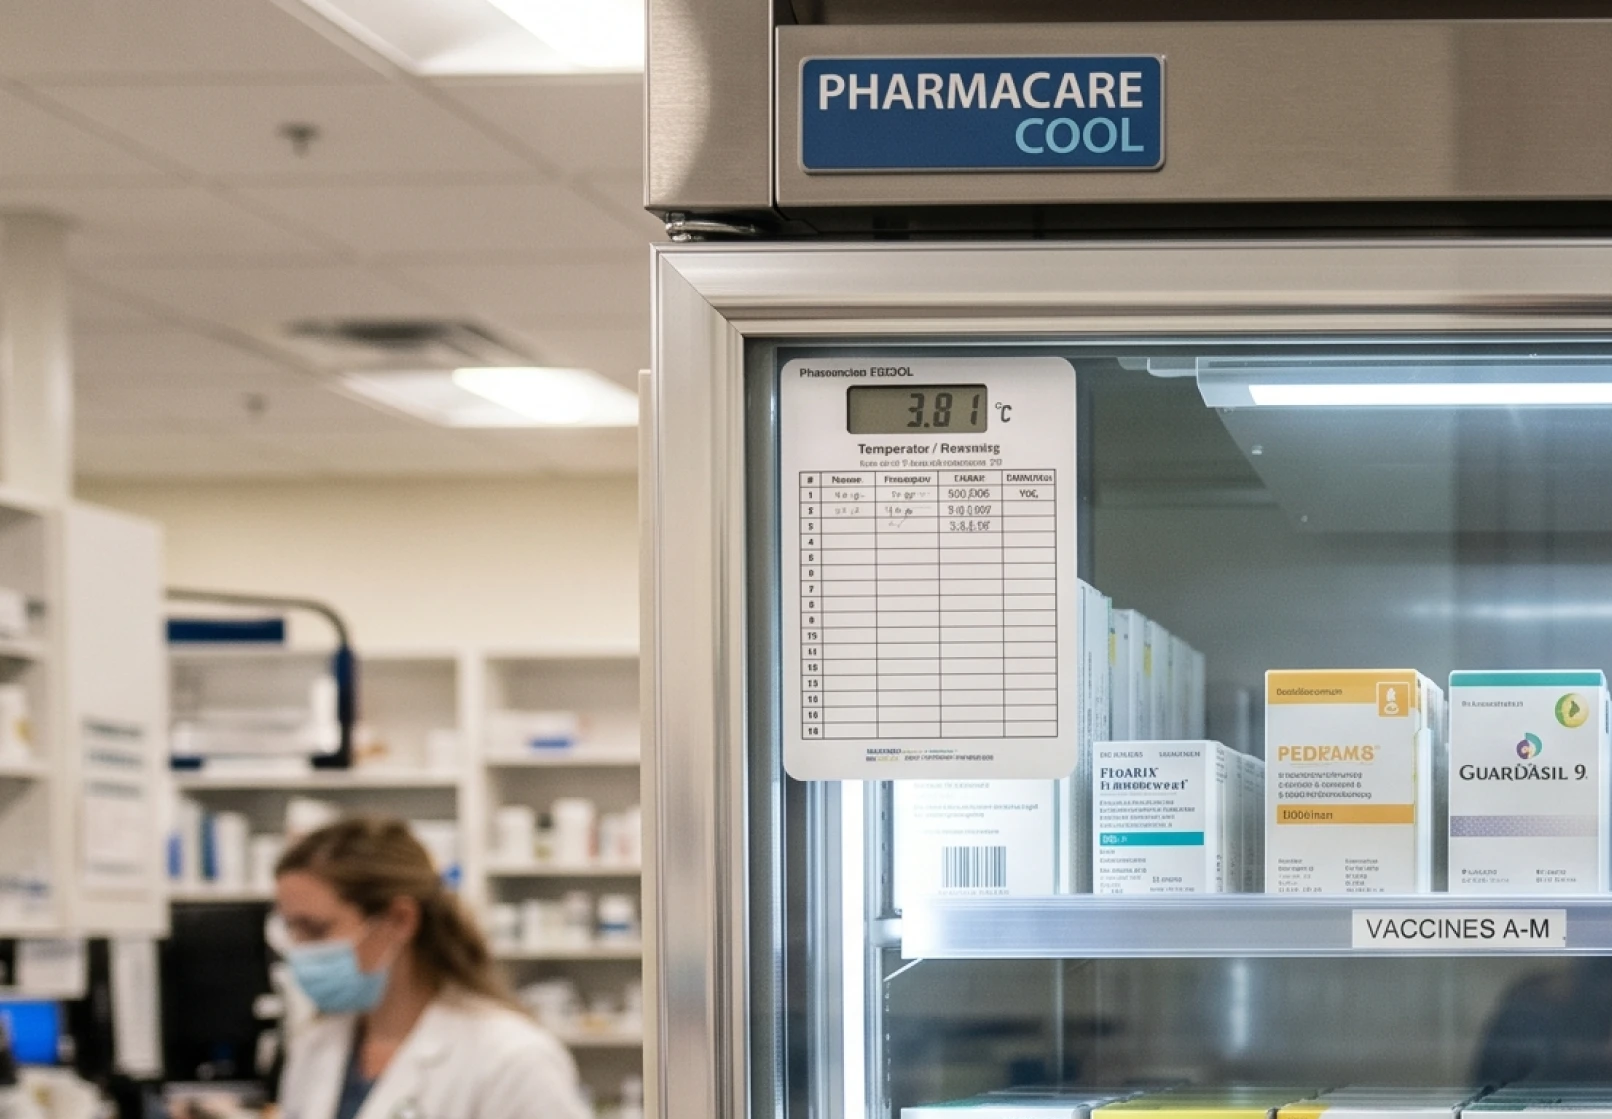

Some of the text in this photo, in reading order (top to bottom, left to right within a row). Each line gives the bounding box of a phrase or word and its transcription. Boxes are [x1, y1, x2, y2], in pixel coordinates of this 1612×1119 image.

[818, 71, 1144, 110] PHARMACARE
[1015, 117, 1145, 154] COOL
[1366, 918, 1550, 939] VACCINES A-M
